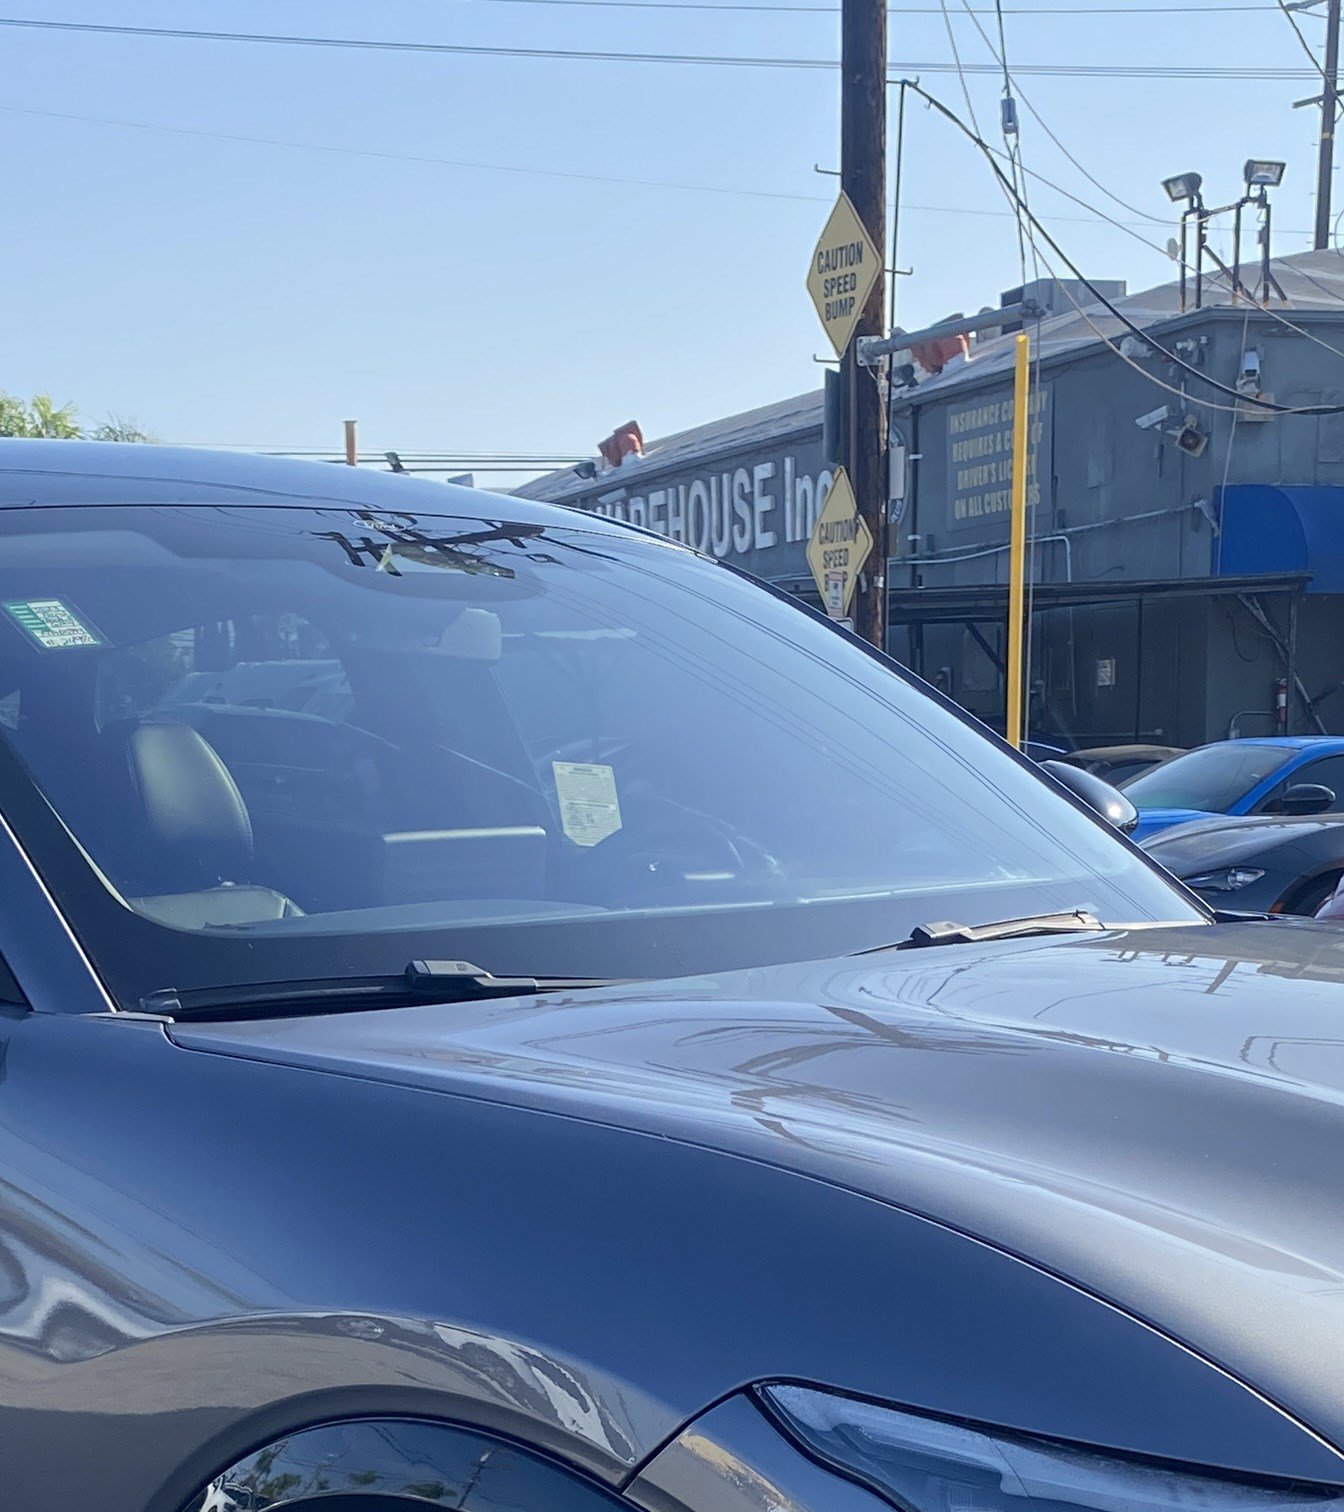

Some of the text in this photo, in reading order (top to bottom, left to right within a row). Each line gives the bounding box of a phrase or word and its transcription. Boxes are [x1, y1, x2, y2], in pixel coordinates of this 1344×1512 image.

[817, 240, 864, 275] CAUTION
[823, 272, 856, 298] SPEED
[825, 297, 855, 321] BUMP
[950, 402, 1000, 434] INSURANCE
[952, 433, 994, 462] REQUIRES
[996, 432, 1002, 453] A
[955, 498, 967, 520] ON
[969, 495, 983, 517] ALL
[818, 518, 857, 546] CAUTION
[823, 548, 849, 569] SPEED
